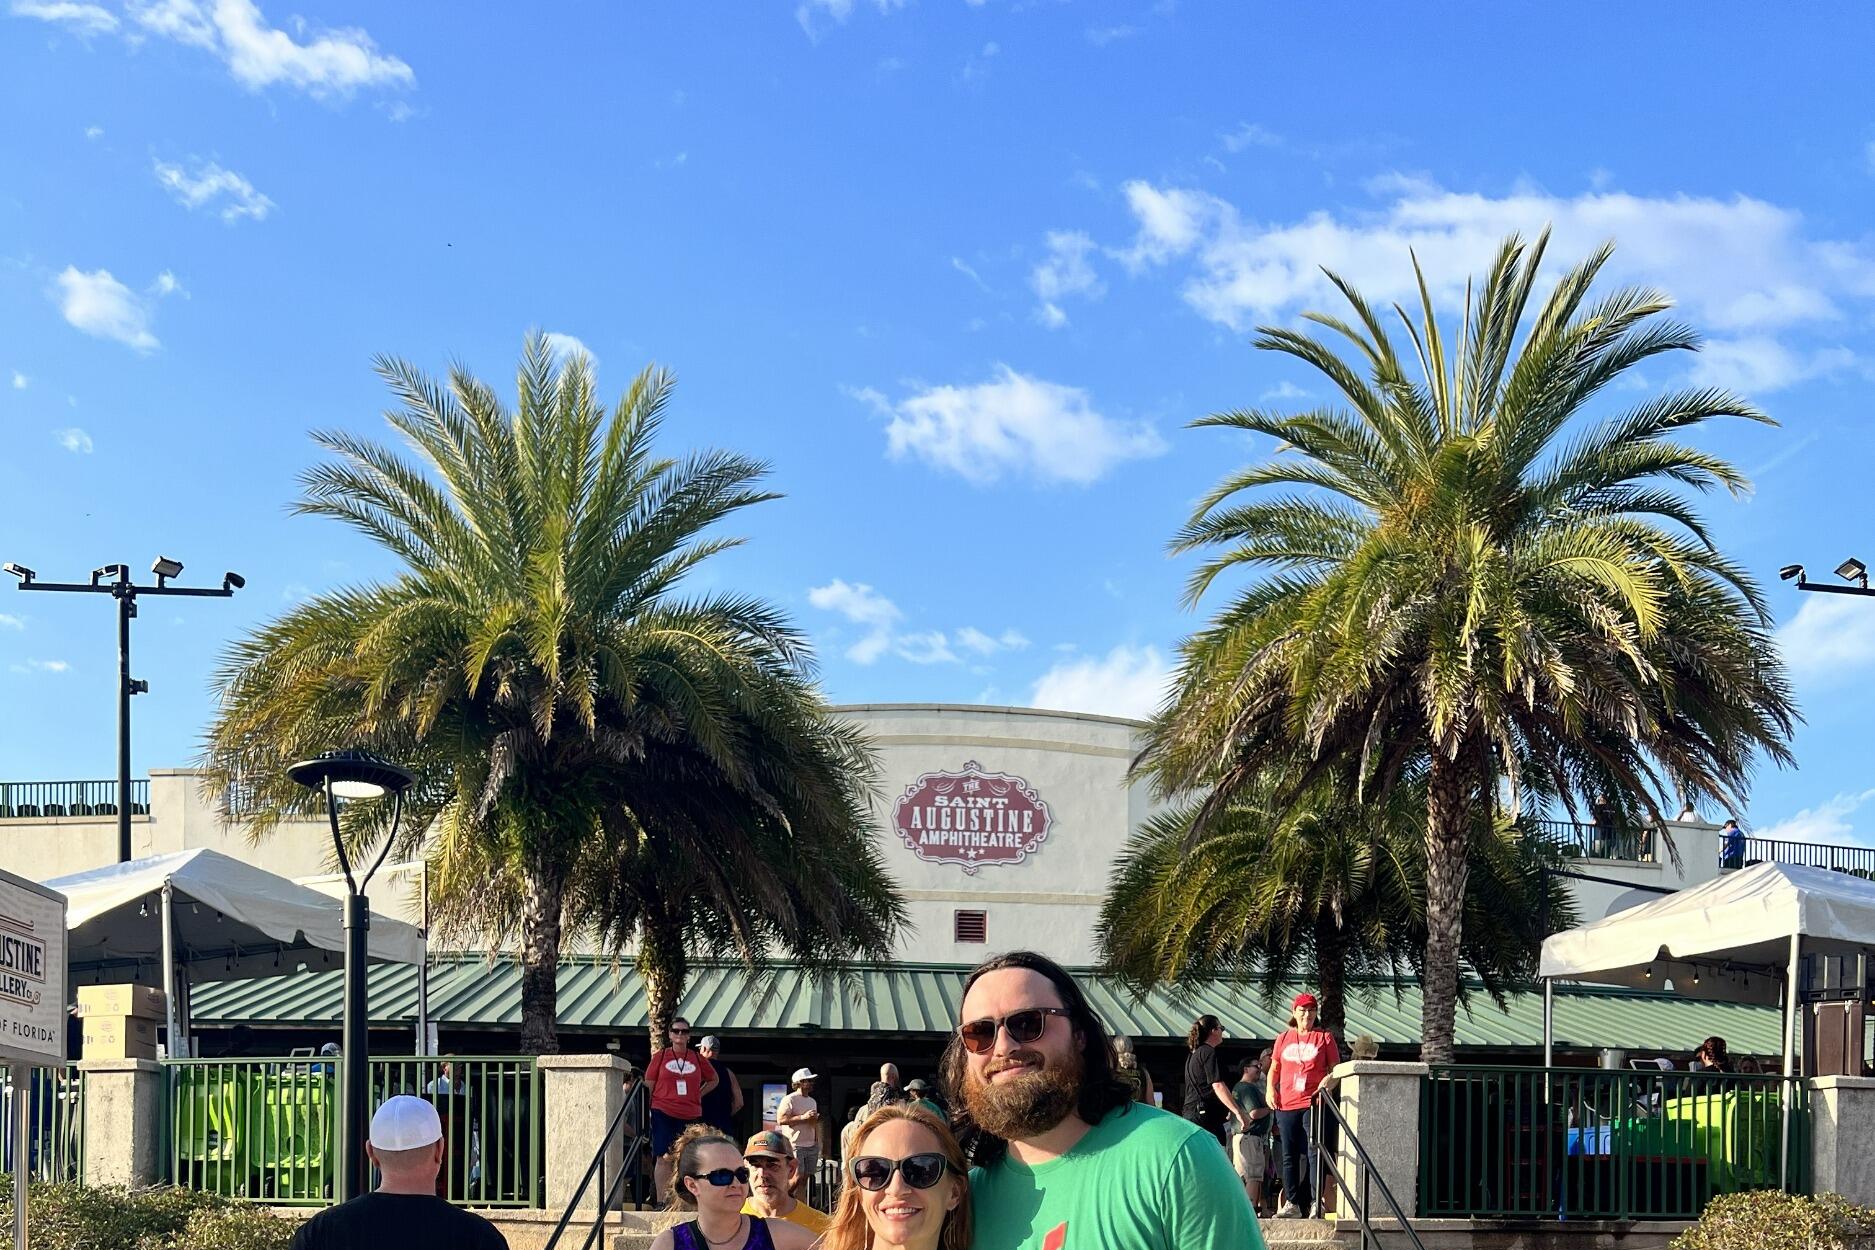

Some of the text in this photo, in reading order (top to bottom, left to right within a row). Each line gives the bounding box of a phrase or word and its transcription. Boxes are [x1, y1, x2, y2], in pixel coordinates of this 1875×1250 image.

[963, 781, 980, 792] THE
[934, 795, 1009, 808] SAINT
[910, 806, 1033, 833] AUGUSTINE
[919, 830, 1023, 848] AMPHITHEATRE
[0, 1018, 54, 1043] F FLORIDA
